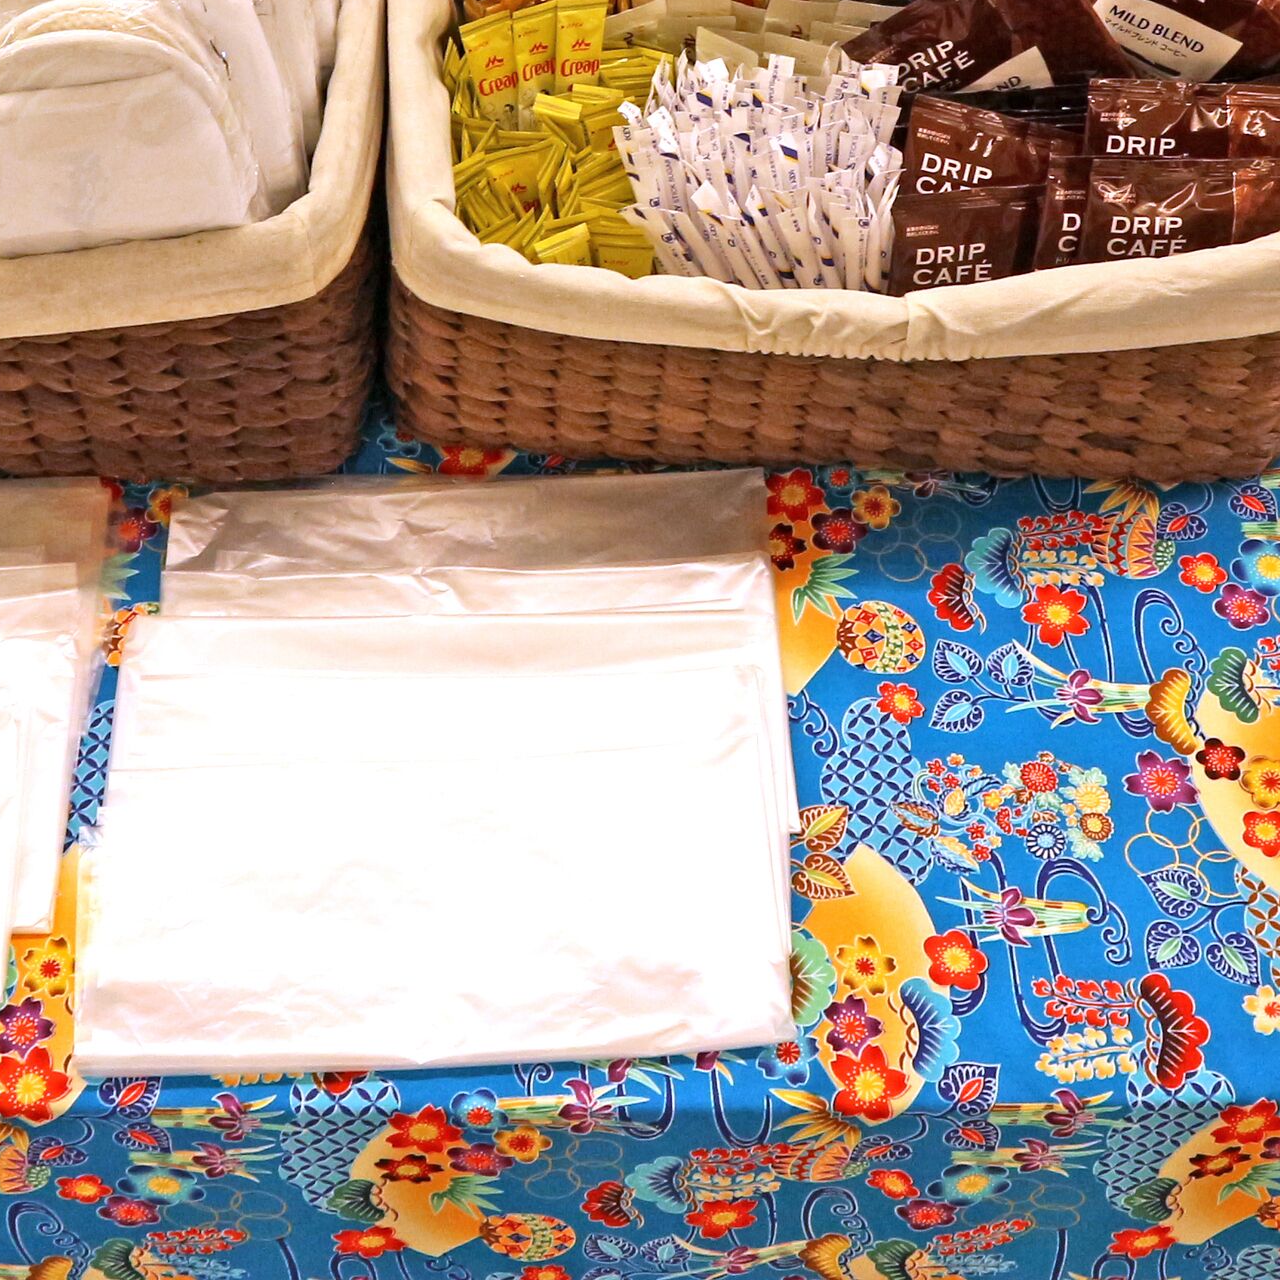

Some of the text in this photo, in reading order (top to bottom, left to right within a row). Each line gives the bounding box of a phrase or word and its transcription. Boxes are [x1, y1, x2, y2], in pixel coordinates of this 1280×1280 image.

[1108, 4, 1205, 54] MILD BLEND
[560, 58, 600, 78] Creap
[902, 50, 975, 94] CAFÉ
[478, 70, 519, 97] Creap
[1106, 135, 1176, 156] DRIP
[921, 152, 993, 185] DRIP
[1110, 216, 1183, 235] DRIP
[916, 242, 986, 265] DRIP
[1106, 234, 1187, 256] CAFÉ
[912, 259, 993, 286] CAFÉ
